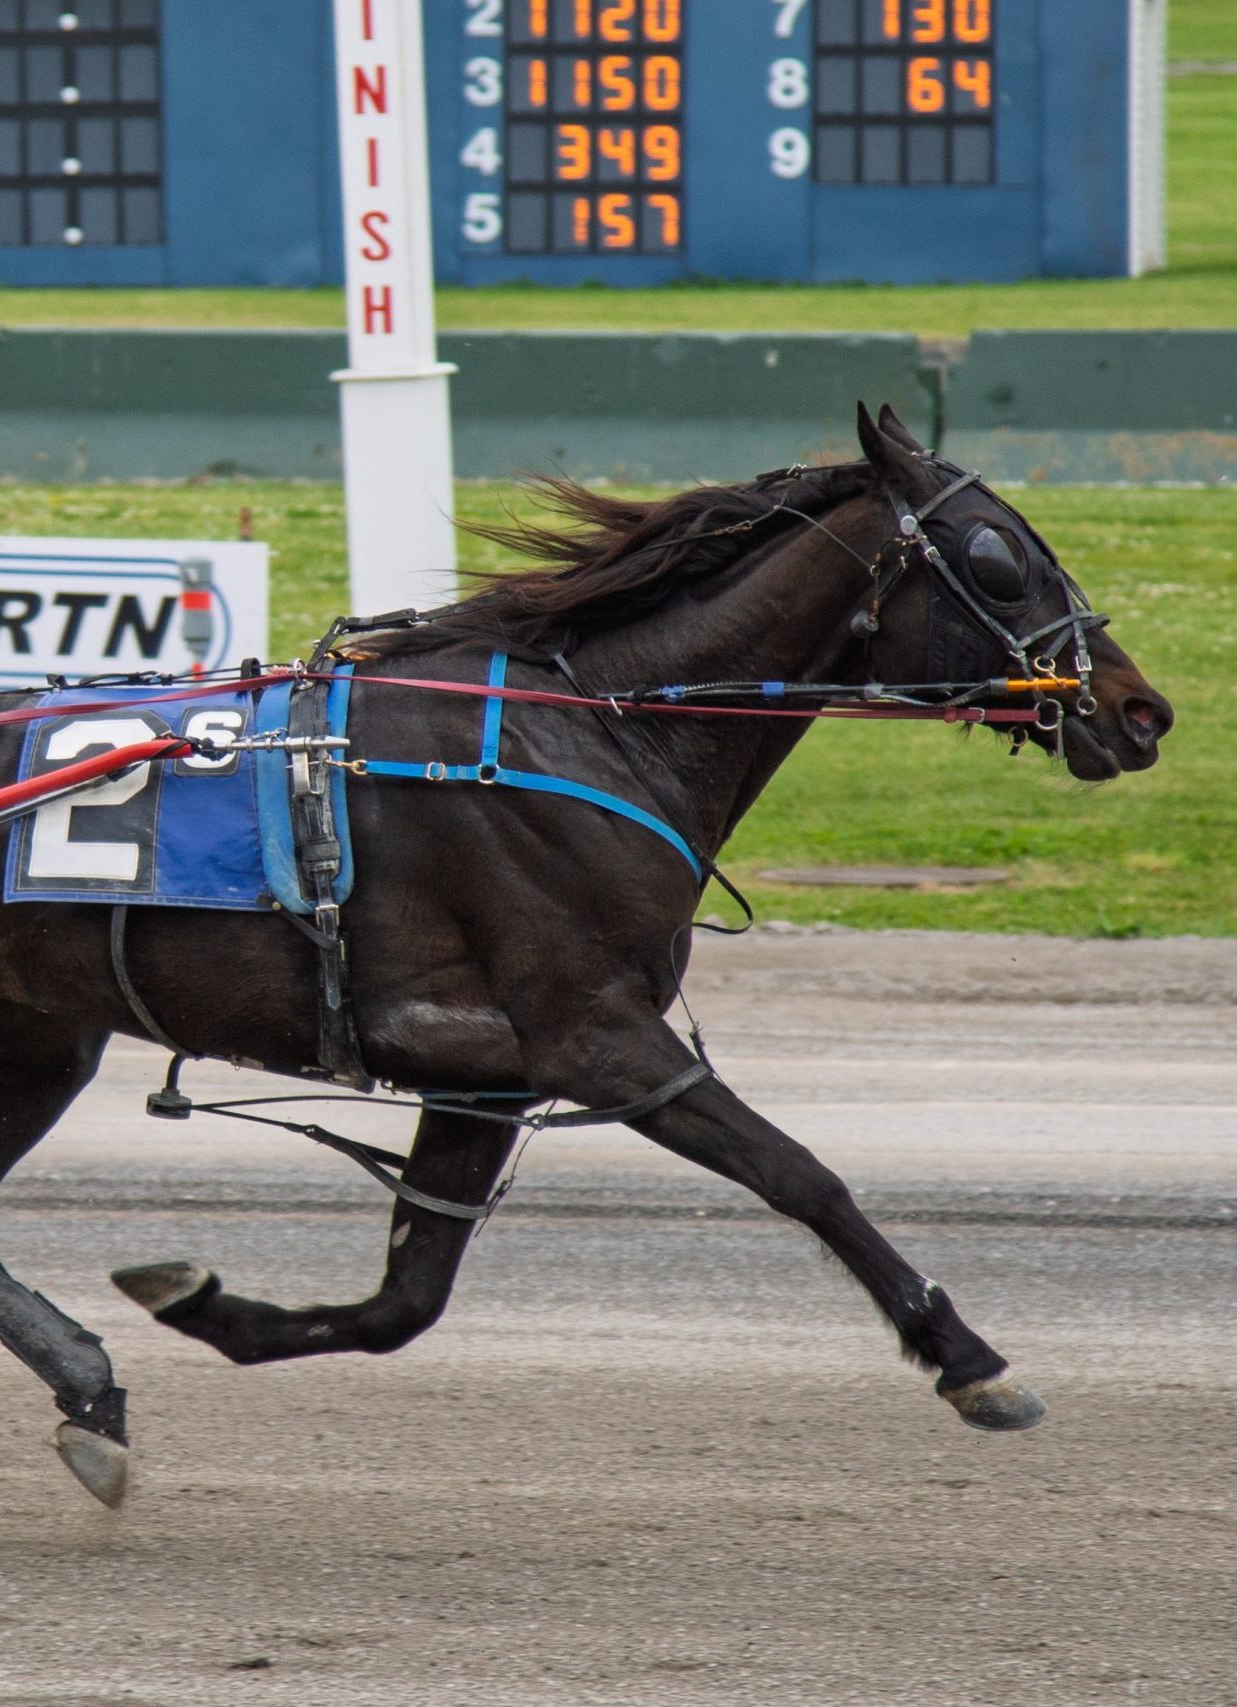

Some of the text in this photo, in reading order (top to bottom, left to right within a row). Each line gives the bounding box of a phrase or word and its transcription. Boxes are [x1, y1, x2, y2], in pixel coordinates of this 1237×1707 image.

[464, 0, 503, 37] 2
[528, 0, 681, 42] 1120
[773, 0, 806, 37] 7
[882, 0, 991, 43] 130
[464, 57, 503, 107] 3
[528, 55, 681, 111] 1150
[767, 58, 809, 109] 8
[907, 57, 991, 112] 64
[460, 128, 502, 177] 4
[558, 124, 680, 181] 349
[769, 127, 810, 178] 9
[463, 194, 502, 243] 5
[573, 193, 680, 248] 157
[28, 719, 153, 881] 2
